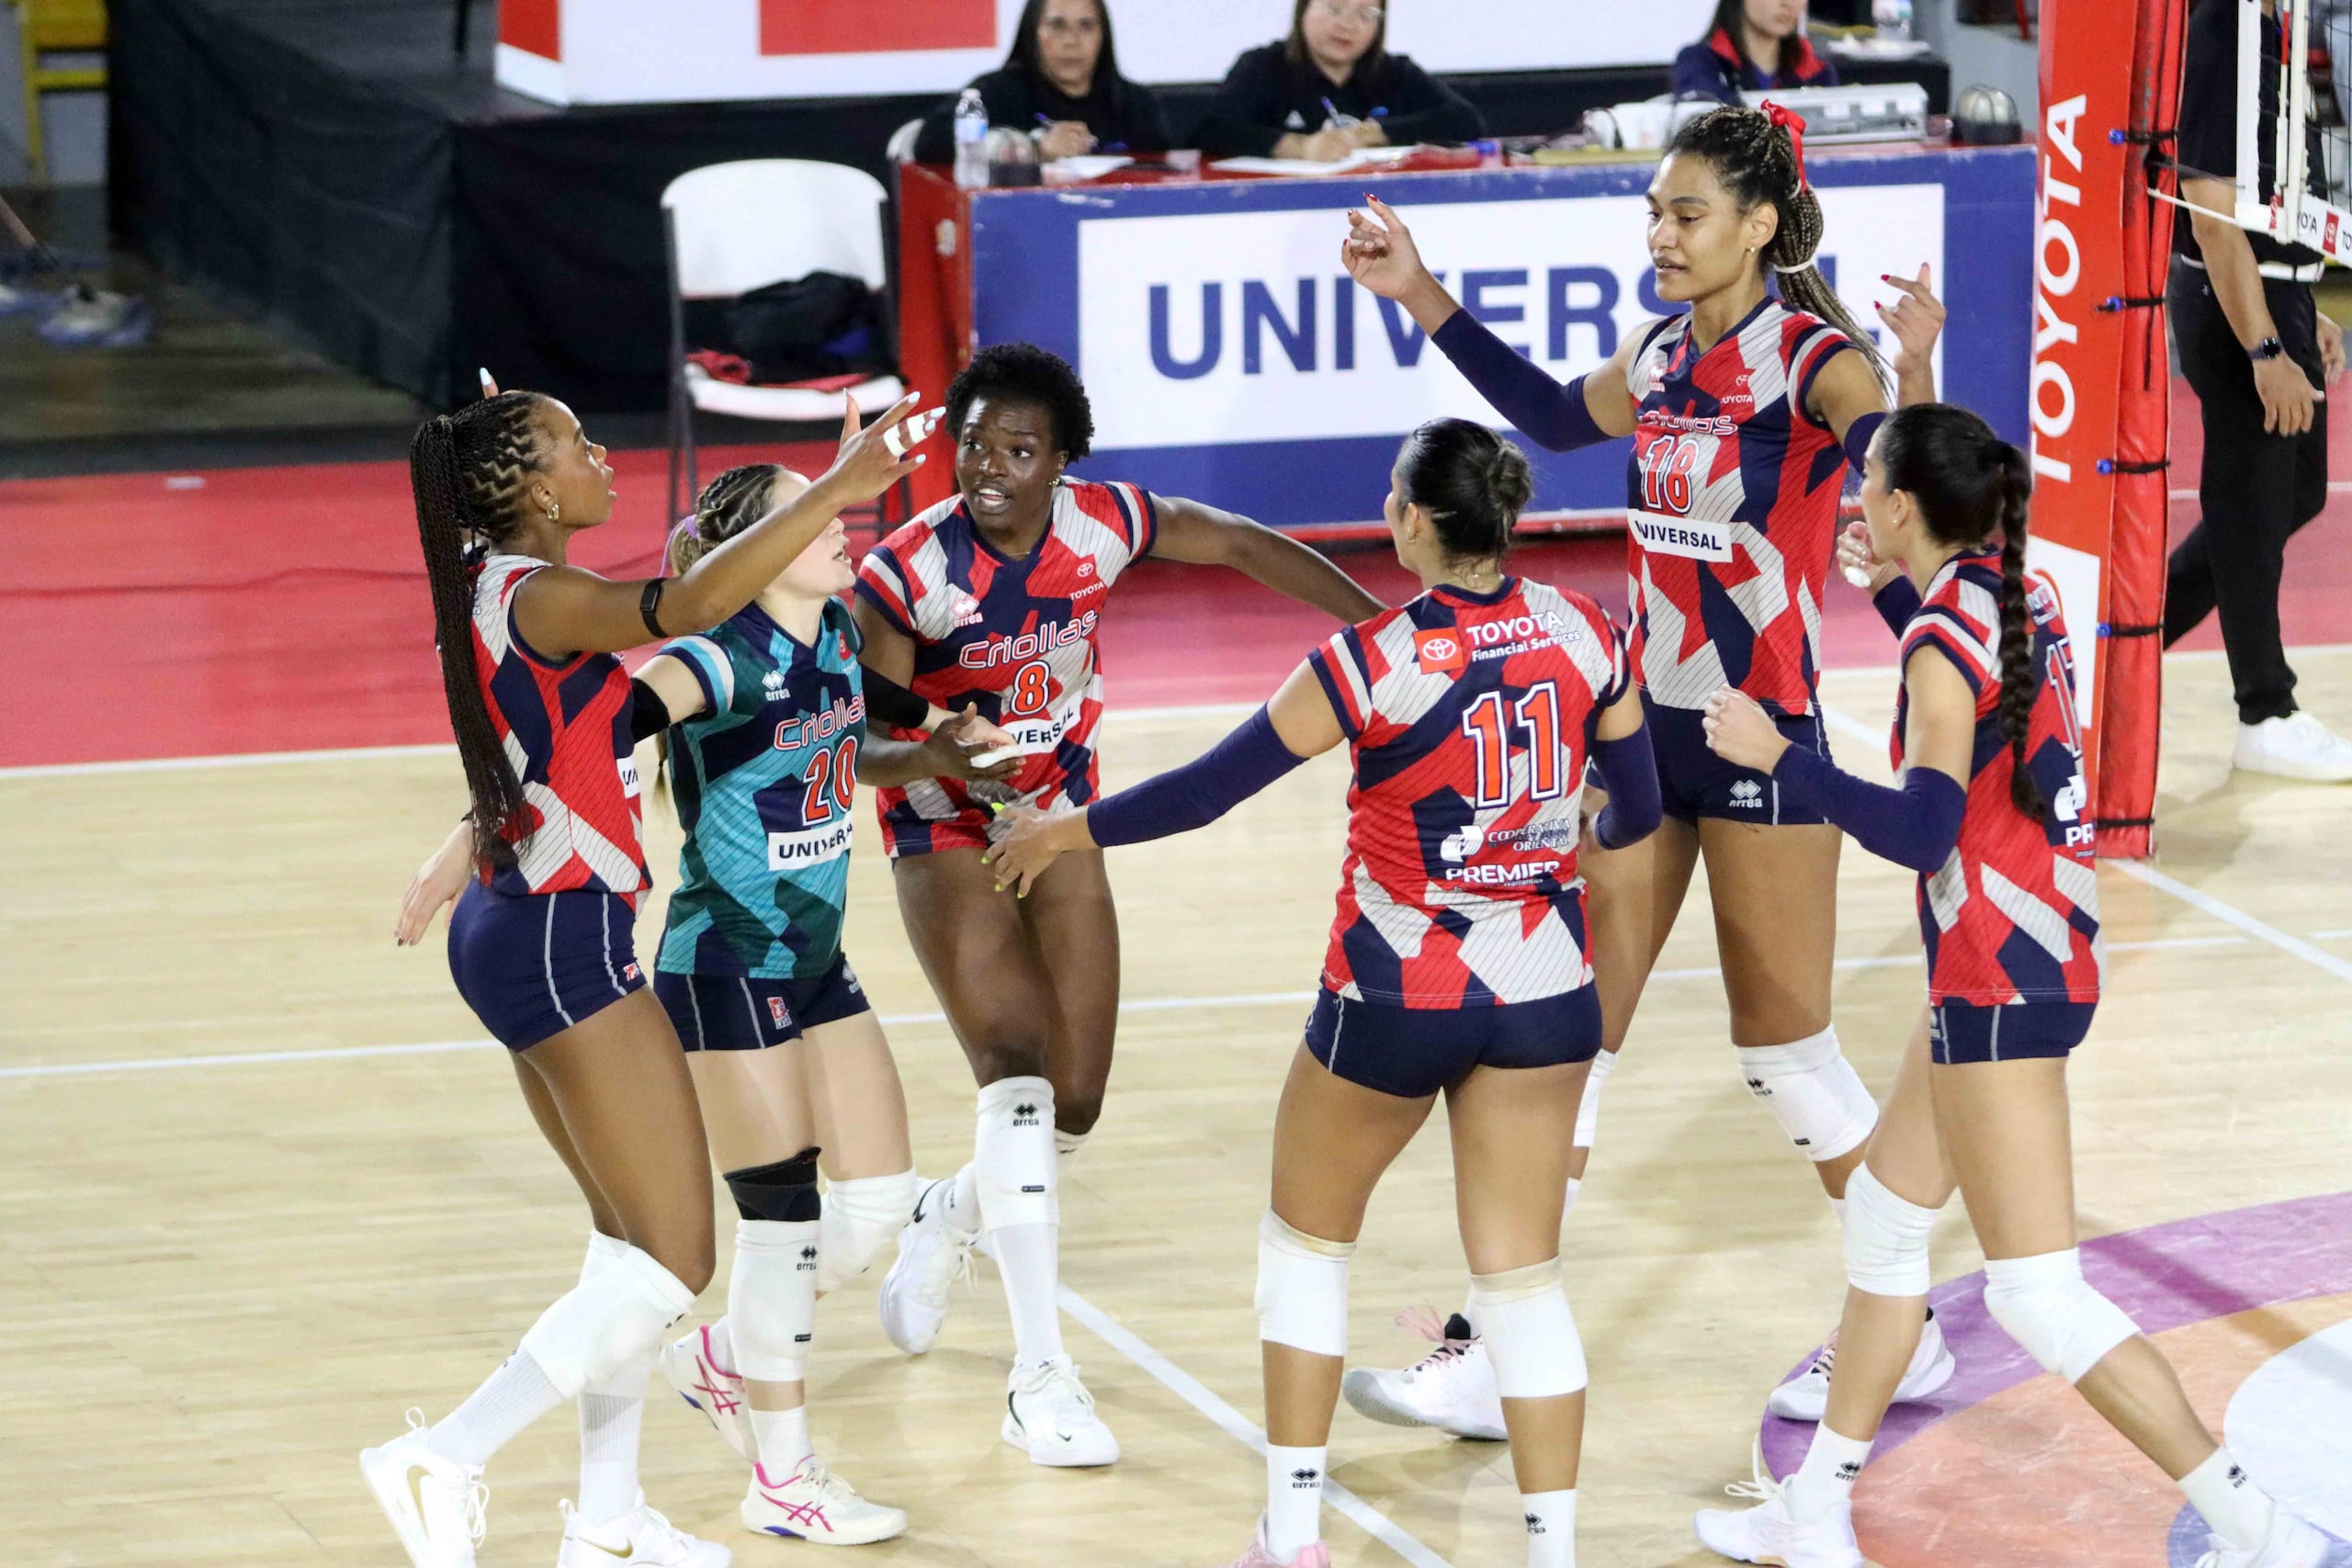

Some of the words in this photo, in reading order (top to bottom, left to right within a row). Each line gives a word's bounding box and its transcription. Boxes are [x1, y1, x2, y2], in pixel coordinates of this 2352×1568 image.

[2030, 94, 2086, 491] TOYOTA
[1148, 255, 1877, 379] UNIVERL
[1719, 395, 1754, 403] OYOTA
[1641, 434, 1700, 514] 18
[1634, 520, 1723, 550] NIVERSAL
[1069, 581, 1103, 601] TOYOTA
[955, 612, 984, 628] errea
[958, 609, 1098, 669] Criollas
[1465, 609, 1567, 646] TOYOTA
[1471, 641, 1529, 663] Financial
[1530, 629, 1580, 650] Services
[764, 688, 791, 702] errea
[1010, 660, 1050, 716] 8
[774, 689, 865, 751] Criollas
[1011, 706, 1074, 745] VERSL
[1462, 678, 1563, 810] 11
[802, 735, 858, 827] 20
[1013, 1118, 1040, 1127] errea
